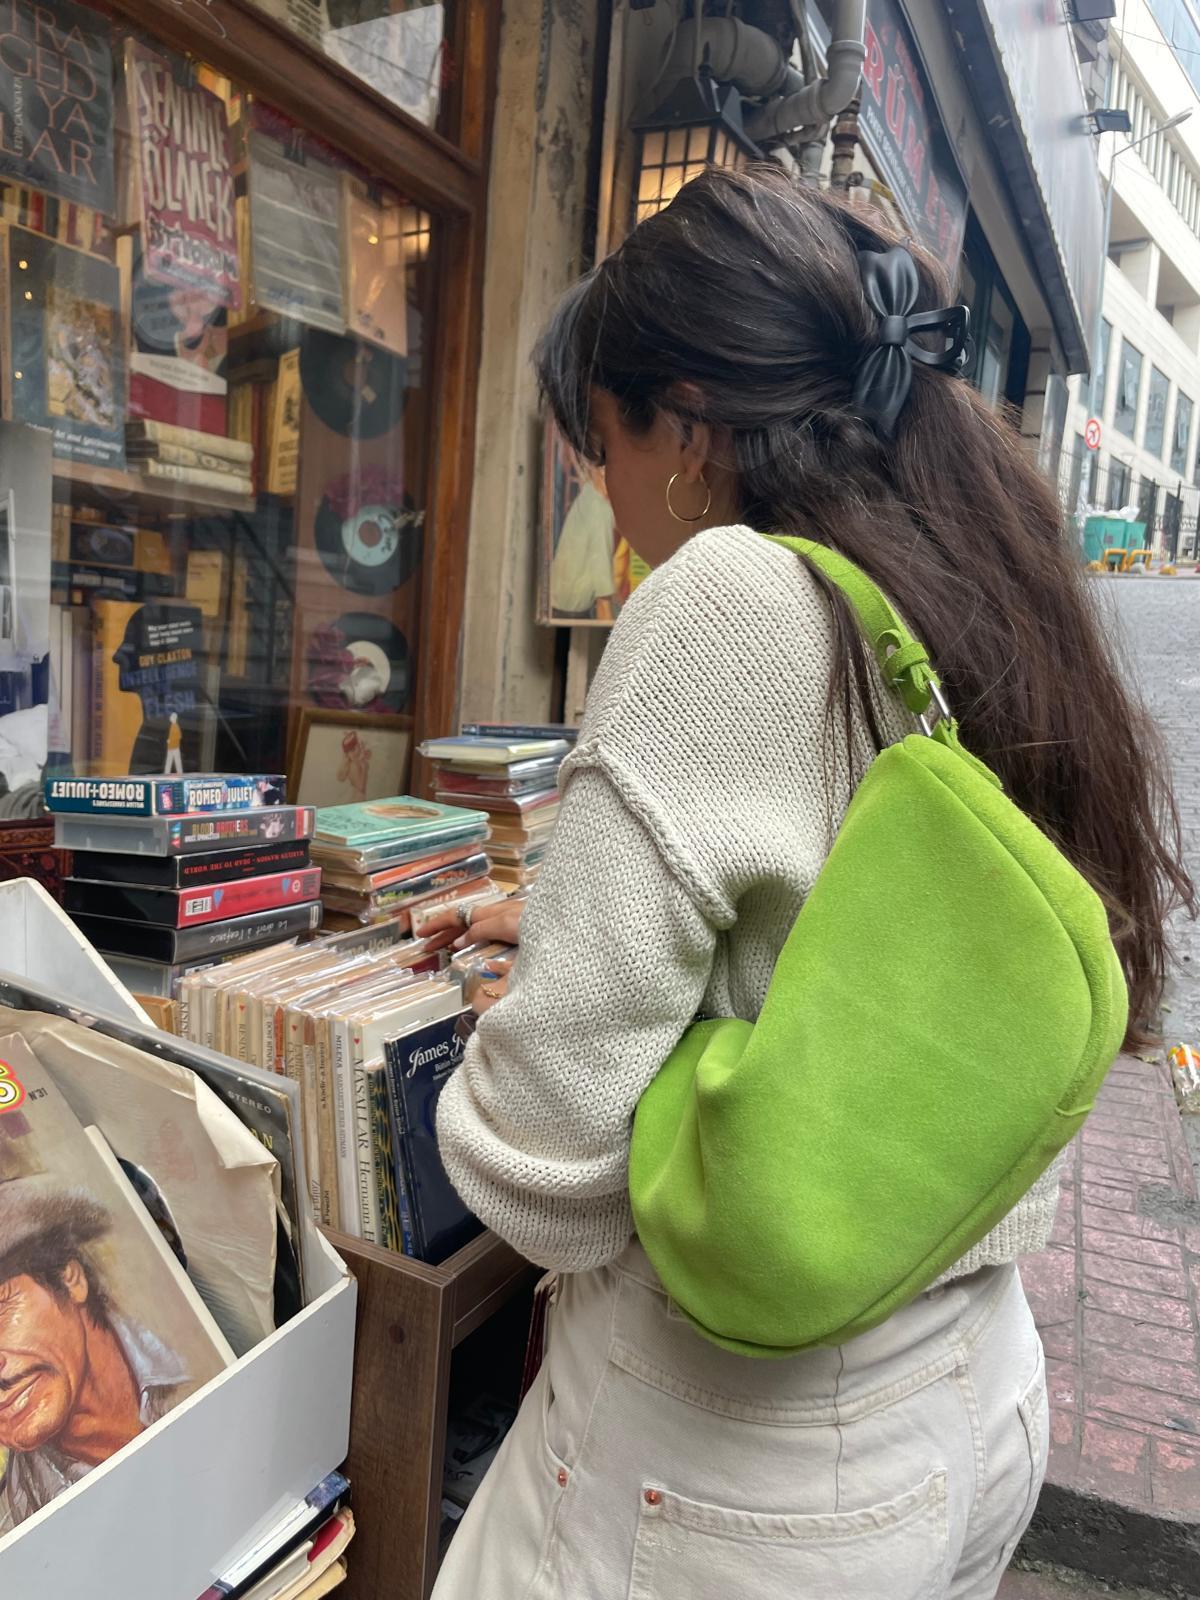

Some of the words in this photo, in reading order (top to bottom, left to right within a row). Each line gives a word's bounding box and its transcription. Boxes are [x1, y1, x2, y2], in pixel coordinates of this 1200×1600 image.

[0, 33, 97, 101] GED
[35, 85, 95, 144] YA
[0, 111, 97, 186] LAR
[142, 129, 233, 242] ÖLMEK
[190, 787, 221, 806] ROMEO
[227, 786, 253, 802] JULIET
[191, 822, 214, 836] BLOOD
[406, 1041, 449, 1078] James
[227, 1090, 272, 1114] STEREO
[353, 1057, 369, 1149] MASALLAR
[359, 1160, 371, 1230] Hermann
